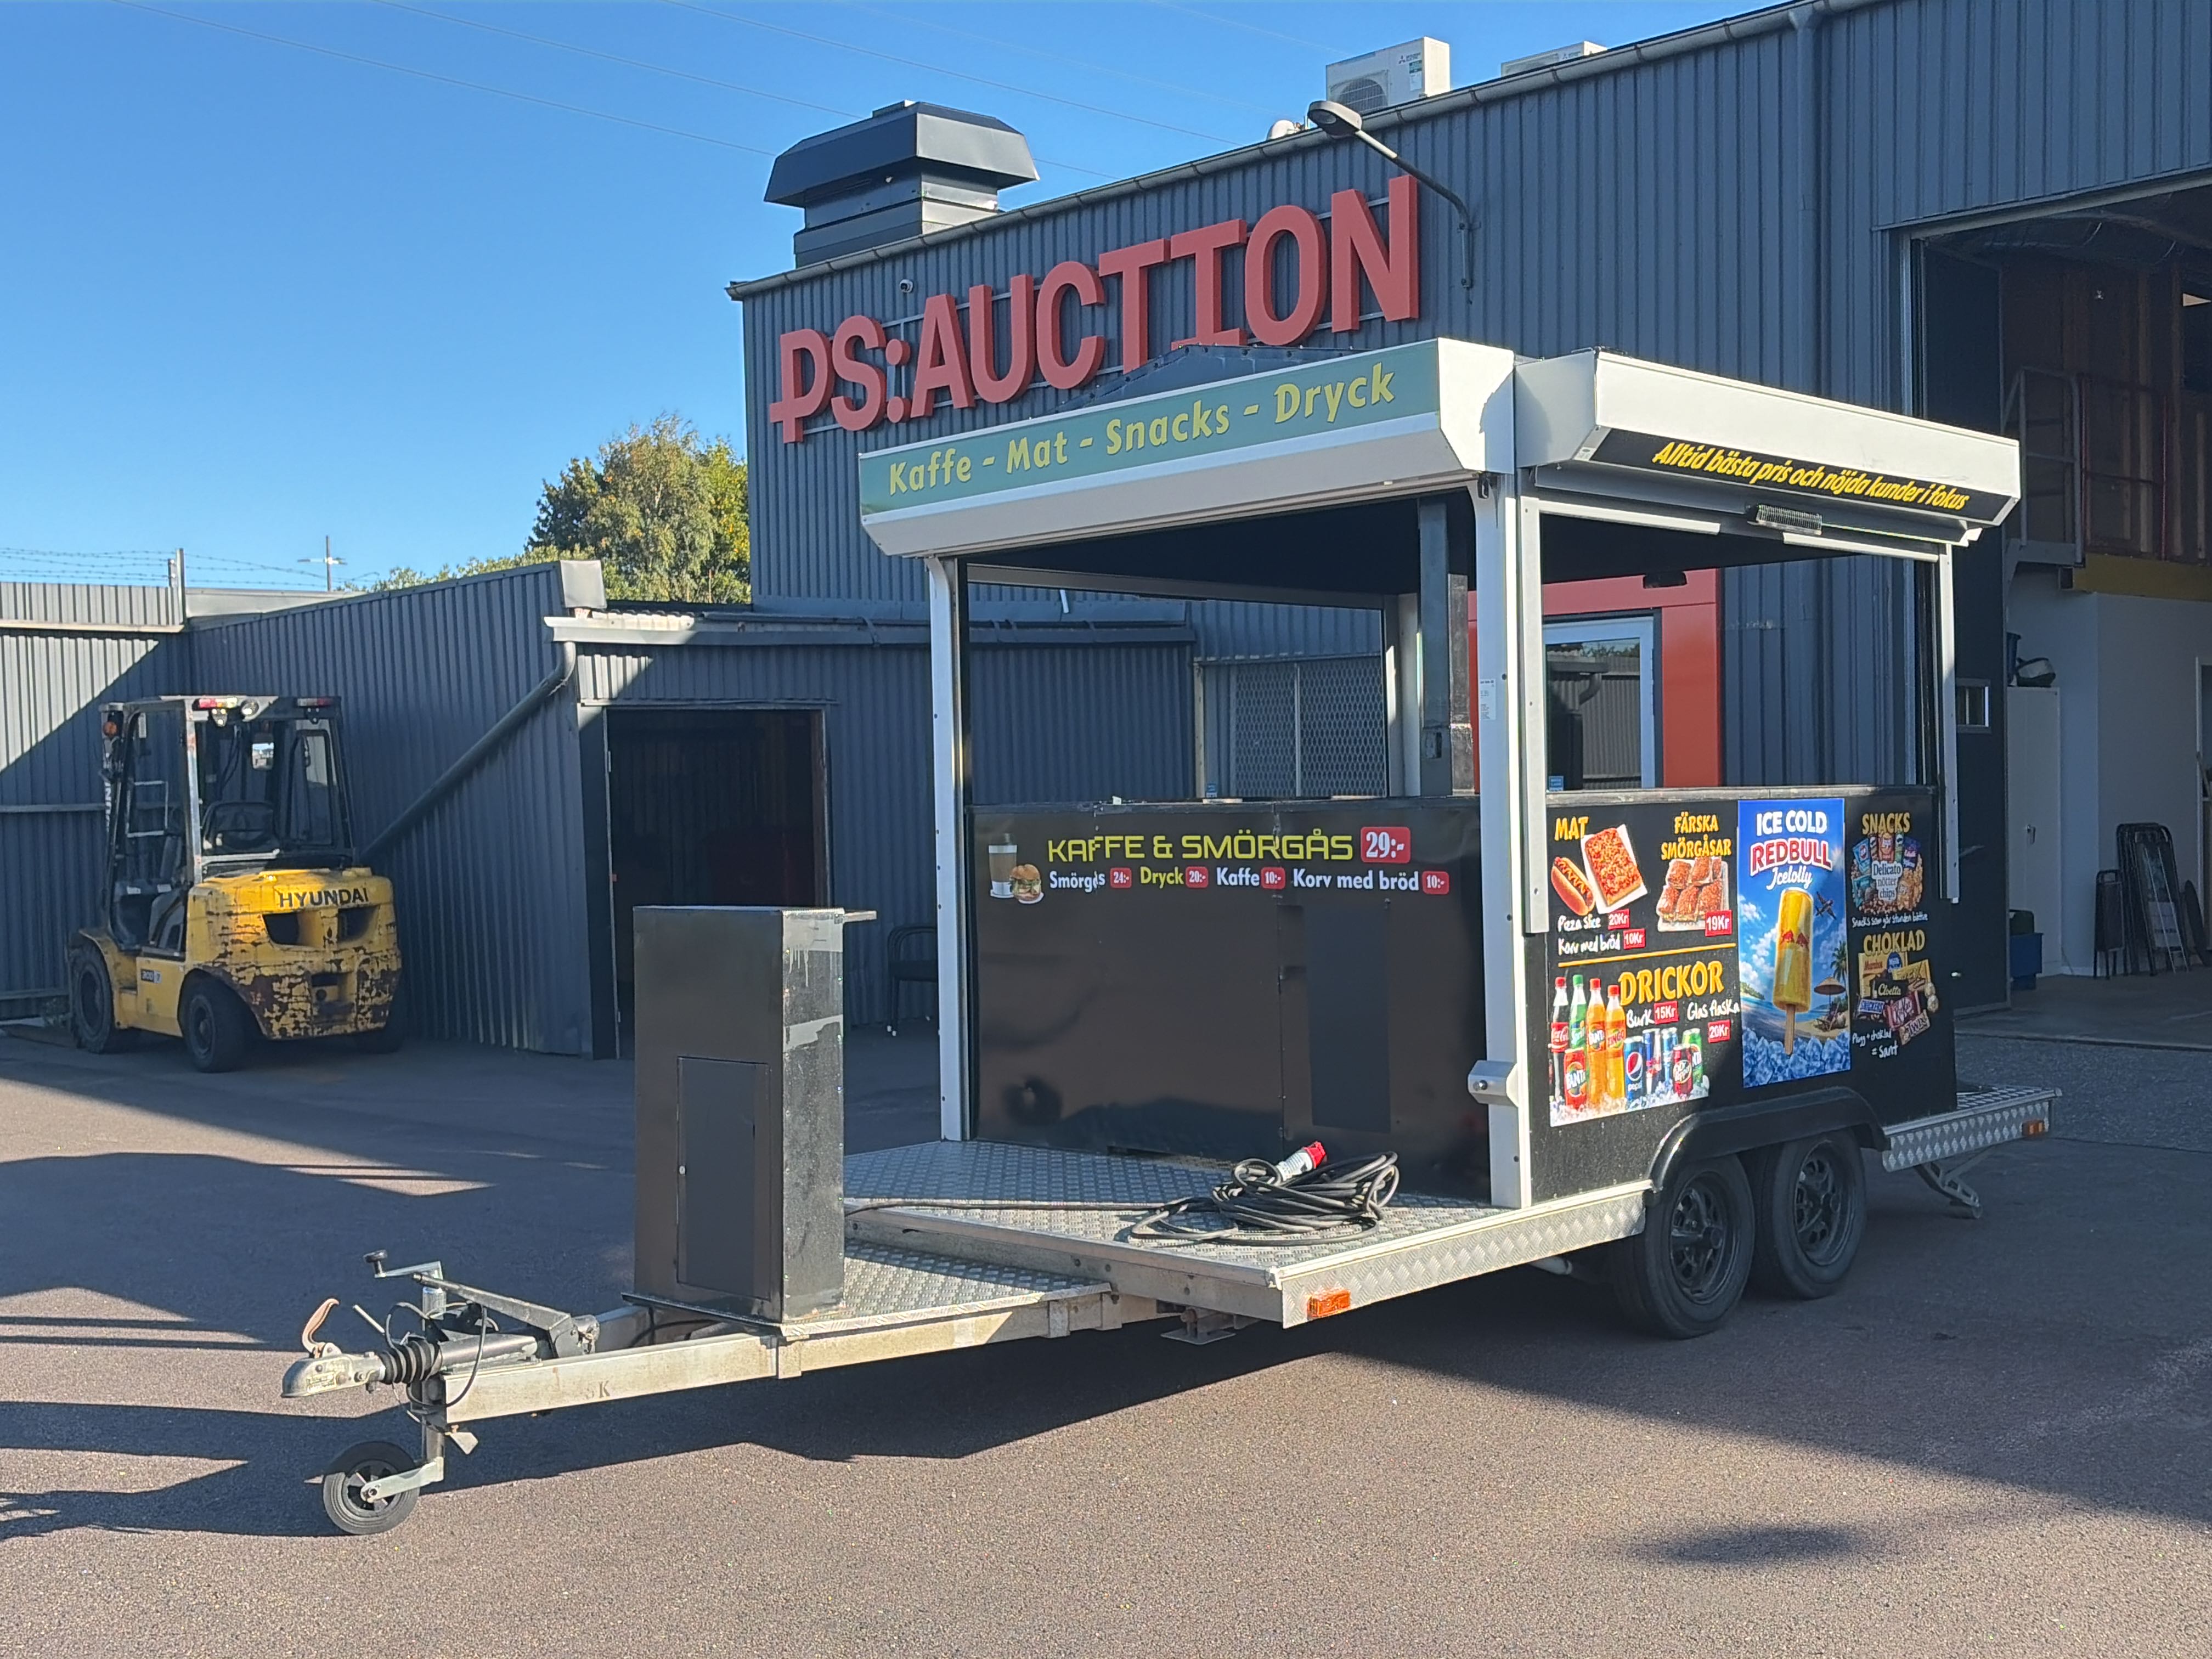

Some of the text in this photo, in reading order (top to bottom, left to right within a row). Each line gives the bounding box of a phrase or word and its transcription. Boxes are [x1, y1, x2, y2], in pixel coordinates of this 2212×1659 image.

[889, 448, 972, 495] Kaffe
[1007, 432, 1068, 473] Mat
[1107, 400, 1229, 455] Snacks
[1273, 362, 1395, 424] Dryck
[1652, 442, 1970, 510] Alltid bästa pris och nöjda kunder i fokus
[1554, 816, 1589, 841] MAT
[1674, 811, 1719, 834] FÄRSKA
[1757, 810, 1827, 836] ICE COLD
[1862, 812, 1910, 834] SNACKS
[1048, 828, 1404, 862] KAFFE & SMÖRGÅS 29:-
[1661, 834, 1732, 860] SMÖRGÅSAR
[1750, 838, 1833, 877] REDBULL
[1140, 866, 1184, 889] Dryck
[1217, 867, 1260, 886] Kaffe
[1293, 868, 1332, 888] Korv
[1337, 870, 1373, 889] med
[1379, 870, 1419, 891] bröd
[1874, 864, 1901, 876] Delicato
[280, 888, 369, 907] HYUNDAI
[1880, 888, 1895, 900] chips
[1609, 913, 1629, 926] 20Kr
[1707, 917, 1730, 931] 19Kr
[1558, 937, 1579, 956] Korv
[1600, 933, 1621, 951] bröd
[1624, 932, 1644, 945] 10Kr
[1863, 929, 1926, 956] CHOKLAD
[1618, 961, 1724, 1006] DRICKOR
[1655, 1006, 1676, 1020] 15Kr
[1709, 1024, 1729, 1038] 20Kr
